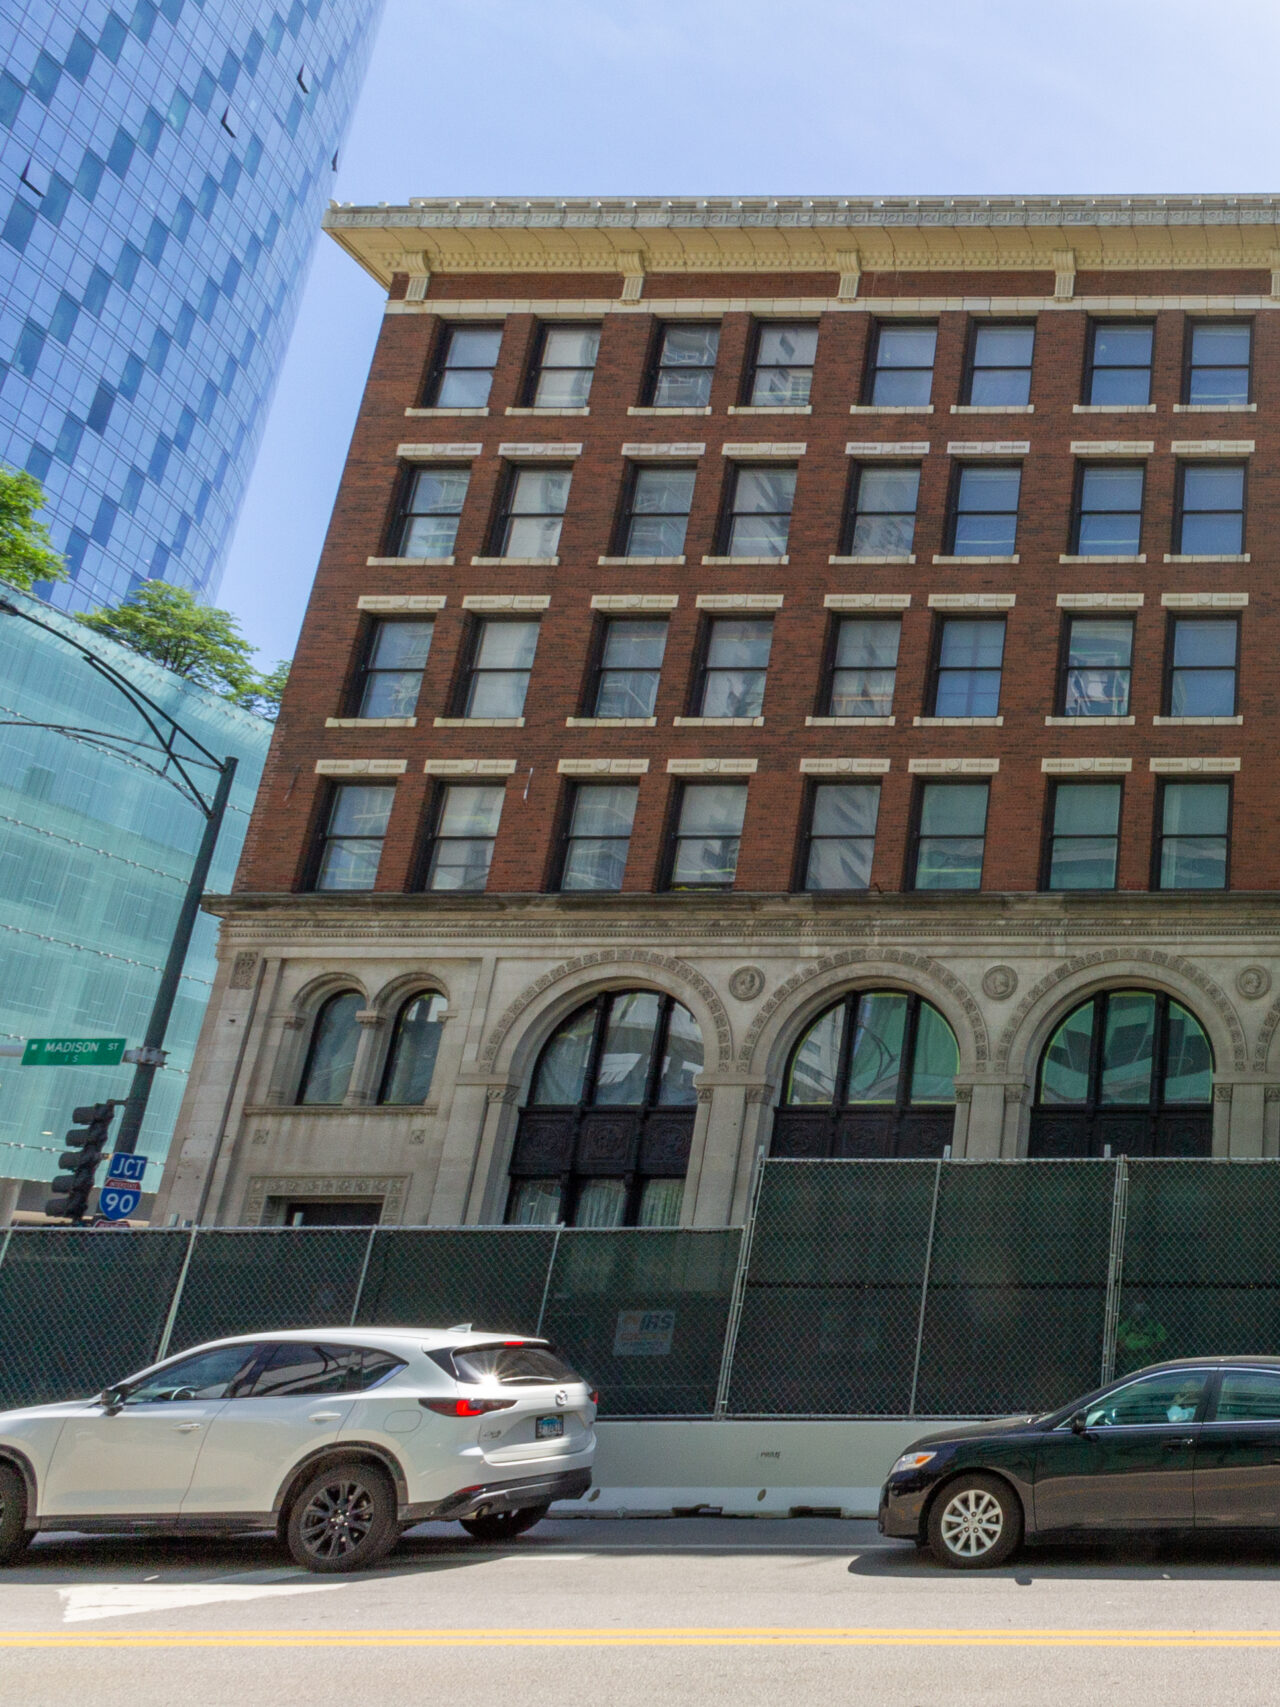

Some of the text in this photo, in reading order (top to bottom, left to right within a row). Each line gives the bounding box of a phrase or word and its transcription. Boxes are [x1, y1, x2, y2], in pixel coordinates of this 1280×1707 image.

[44, 1041, 100, 1053] MADISON
[107, 1042, 119, 1051] ST
[112, 1157, 145, 1179] JCT
[105, 1193, 134, 1213] 90
